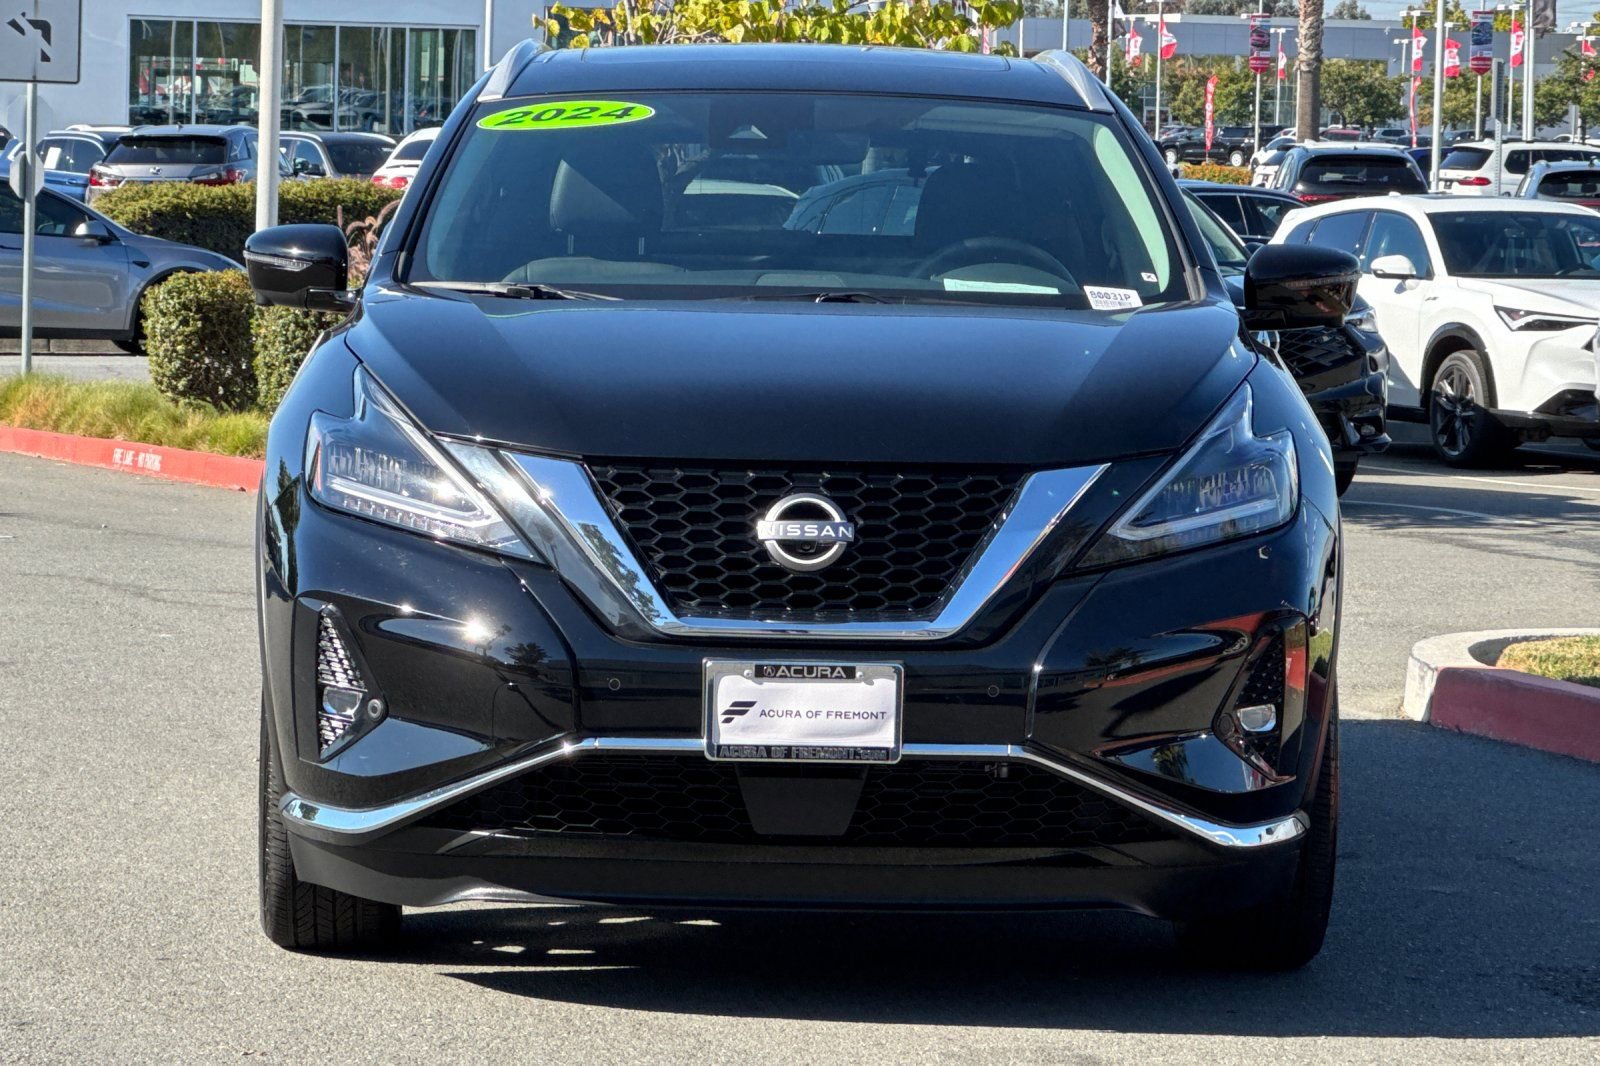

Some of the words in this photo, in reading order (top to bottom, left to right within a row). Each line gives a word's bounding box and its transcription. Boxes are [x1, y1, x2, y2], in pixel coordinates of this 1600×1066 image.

[494, 106, 637, 126] 2024
[1089, 290, 1131, 301] 80031P
[759, 524, 853, 538] NISSAN
[776, 665, 846, 678] ACURA
[759, 709, 801, 719] ACURA
[805, 710, 822, 719] OF
[826, 710, 887, 720] FREMONT
[719, 746, 767, 759] ACURA
[771, 747, 788, 760] OF
